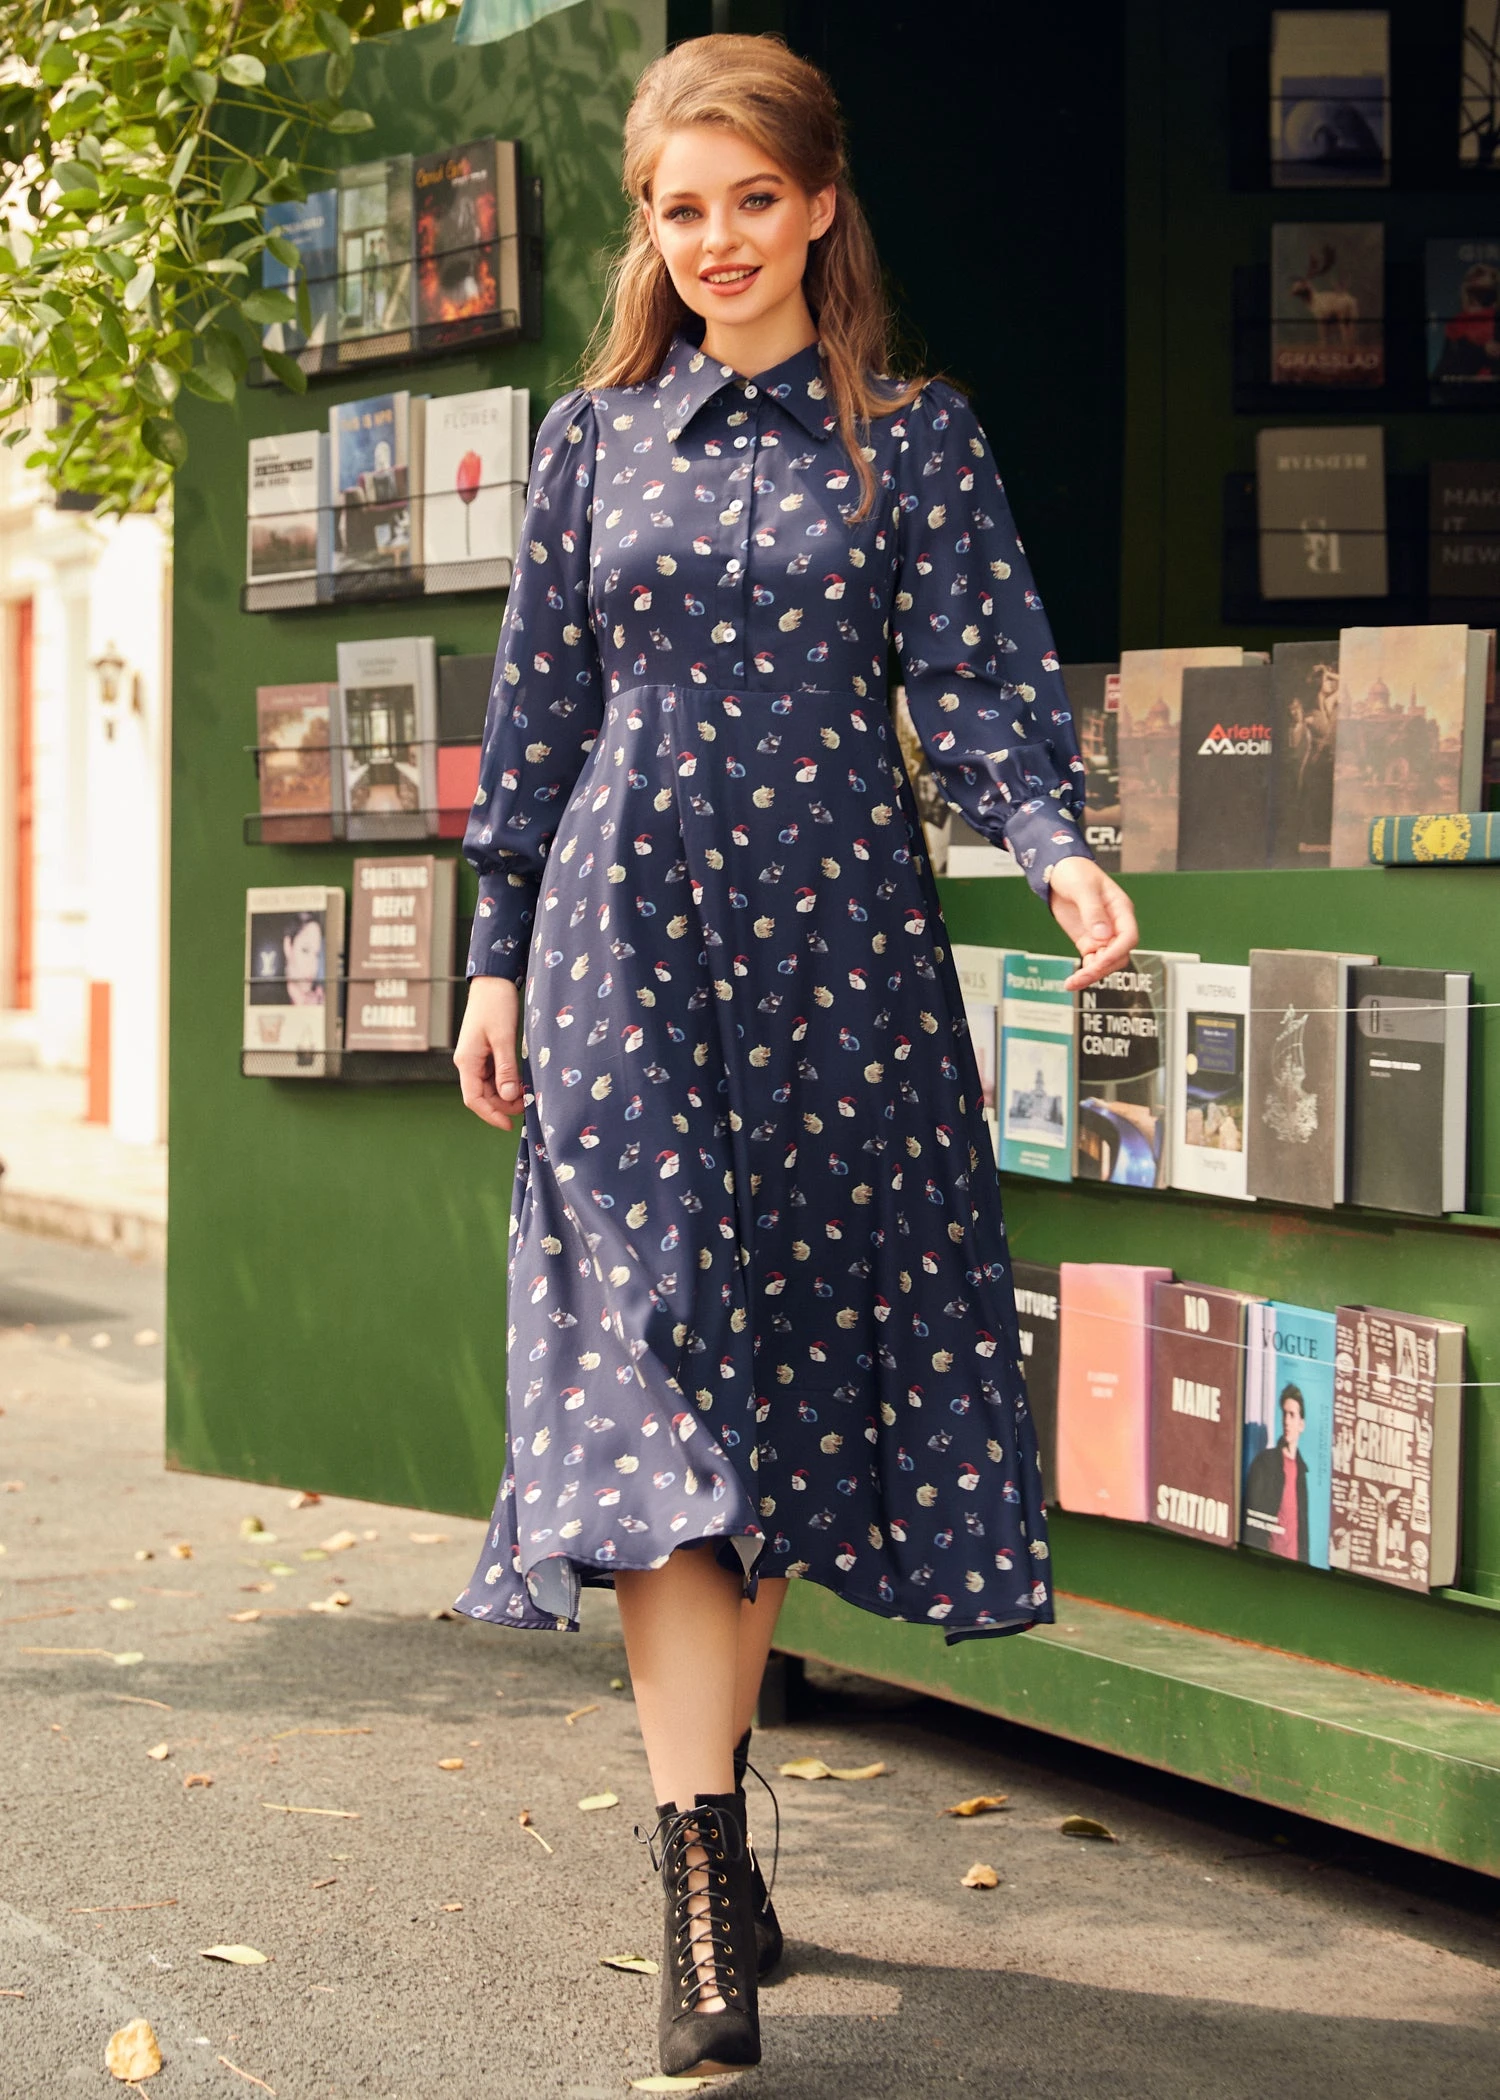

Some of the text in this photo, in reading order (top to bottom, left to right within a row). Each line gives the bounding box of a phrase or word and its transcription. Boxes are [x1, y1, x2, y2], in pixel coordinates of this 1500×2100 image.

[444, 408, 498, 429] FLOWER
[1082, 992, 1097, 1009] IN
[1083, 1013, 1103, 1033] THE
[1106, 1014, 1159, 1037] TWENTIETH
[1082, 1035, 1131, 1057] CENTURY
[1184, 1295, 1210, 1333] NO
[1261, 1327, 1319, 1360] VOGUE
[1171, 1377, 1221, 1424] NAME
[1355, 1419, 1414, 1471] CRIME
[1156, 1485, 1229, 1539] STATION
